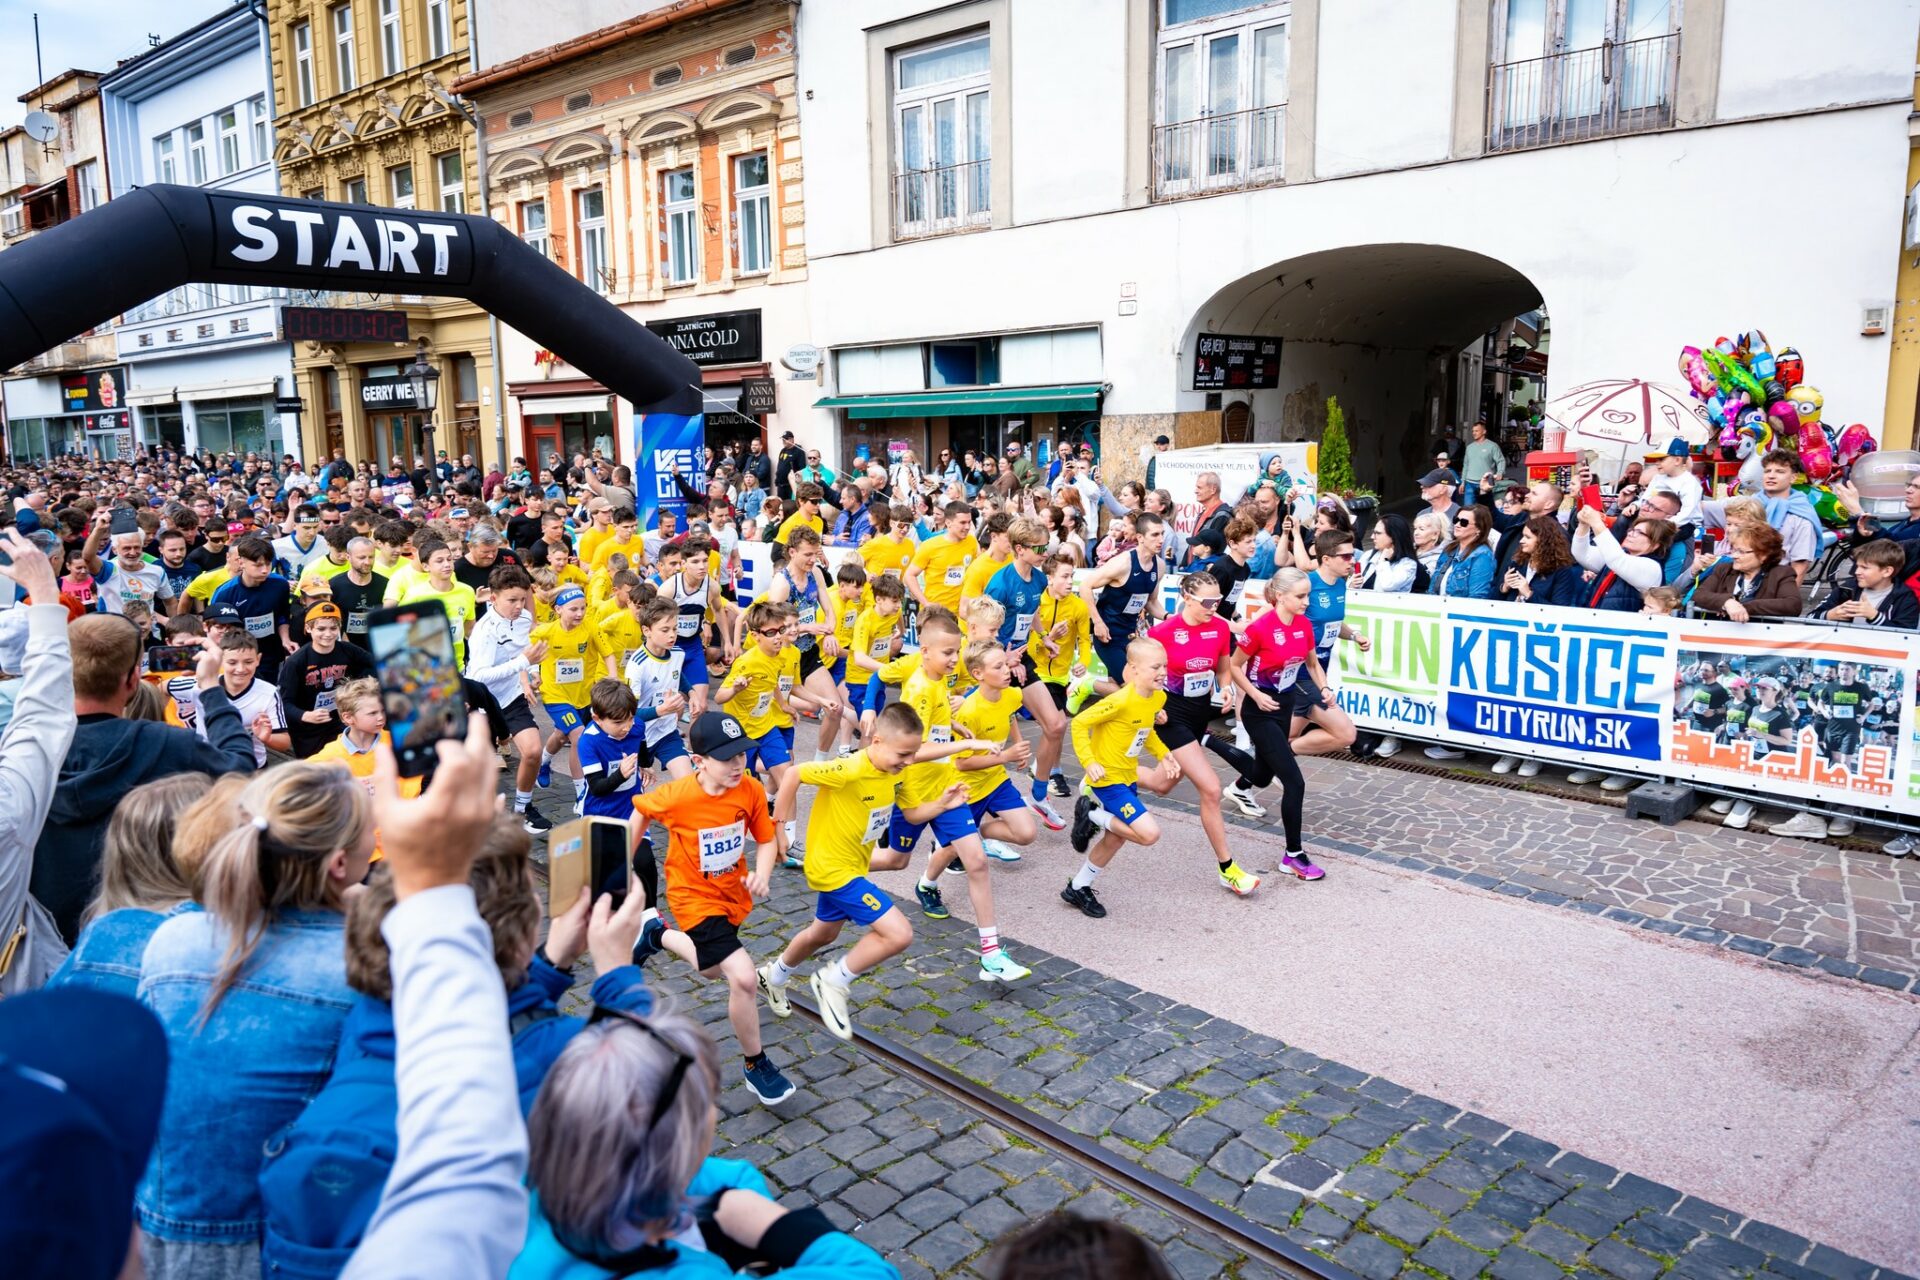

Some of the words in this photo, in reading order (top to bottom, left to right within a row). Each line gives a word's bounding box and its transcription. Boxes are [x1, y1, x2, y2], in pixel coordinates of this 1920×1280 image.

[231, 204, 459, 276] START
[287, 309, 406, 340] 00:00:02
[677, 321, 716, 331] ZLATNÍCTVO
[660, 333, 697, 351] NNA
[698, 329, 739, 347] GOLD
[362, 384, 394, 401] GERRY
[749, 386, 774, 396] ANNA
[749, 397, 774, 406] GOLD
[948, 570, 961, 578] 454
[247, 620, 272, 631] 2569
[677, 621, 698, 629] 1252
[561, 666, 579, 676] 234
[1449, 622, 1665, 714] KOŠICE
[1190, 679, 1209, 691] 178
[1378, 692, 1437, 726] KAŽDÝ
[561, 711, 577, 728] 10
[1475, 700, 1632, 750] CITYRUN.SK
[1120, 802, 1136, 818] 26
[704, 836, 742, 857] 1812
[899, 836, 913, 848] 17
